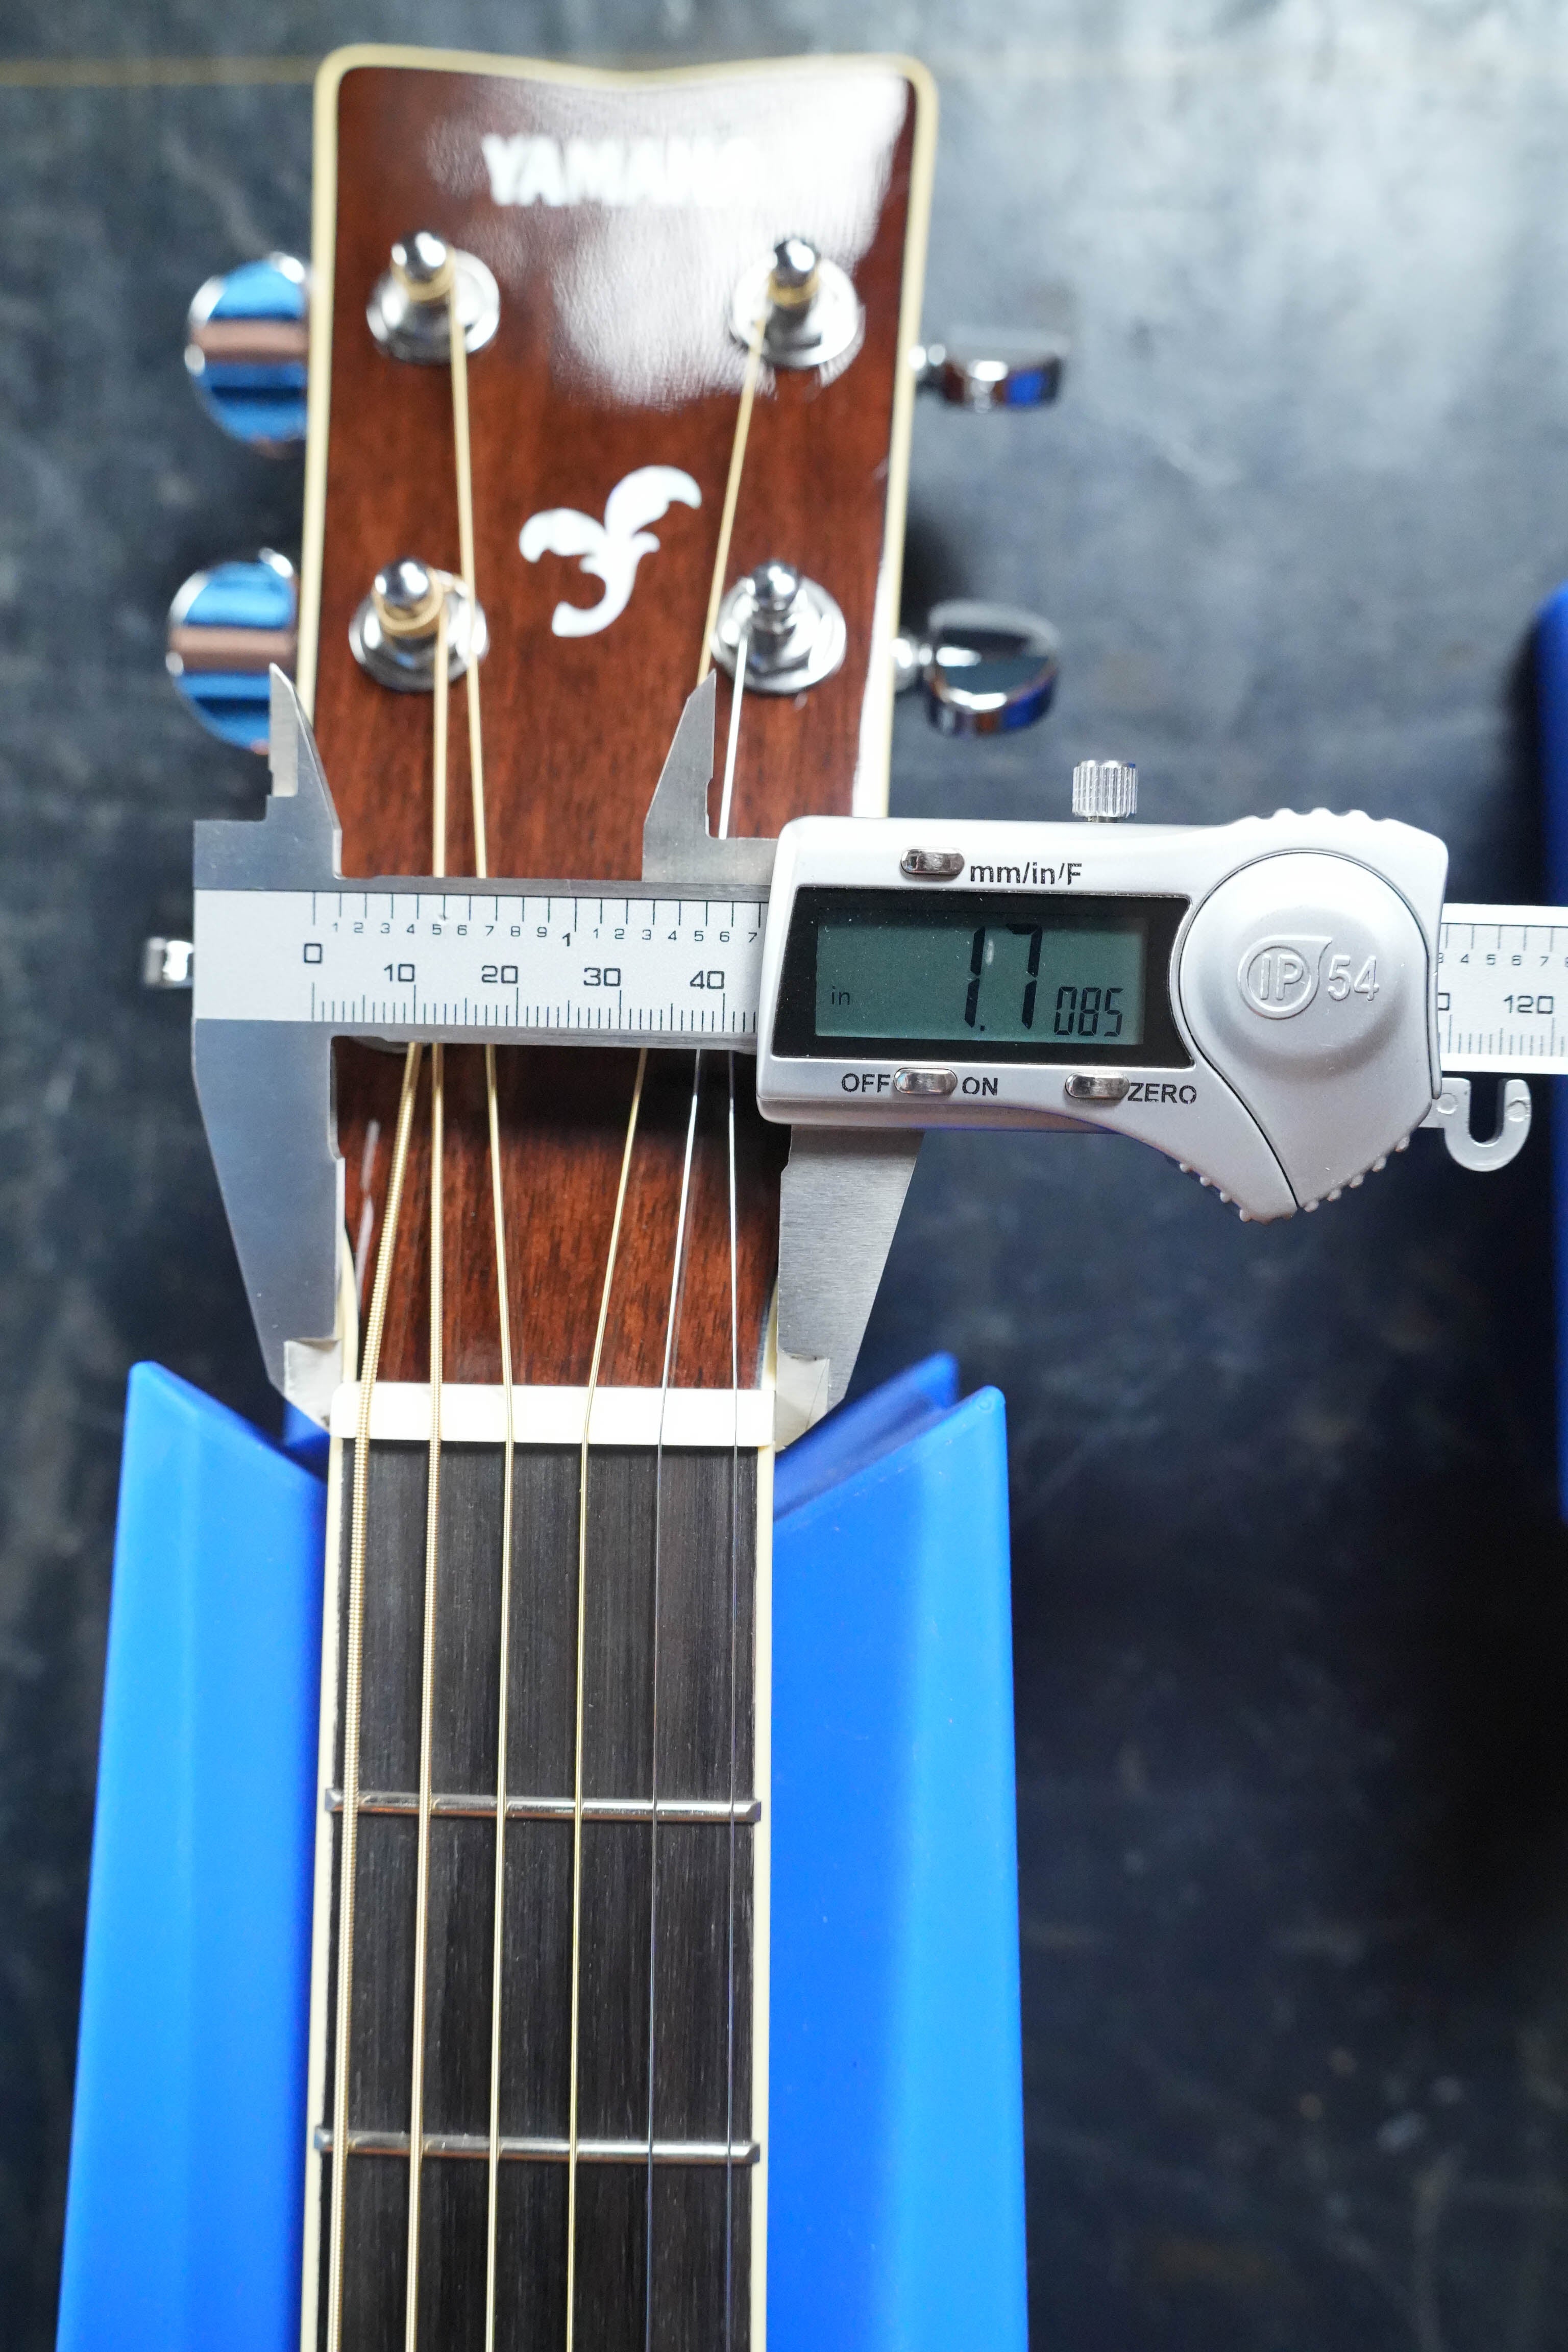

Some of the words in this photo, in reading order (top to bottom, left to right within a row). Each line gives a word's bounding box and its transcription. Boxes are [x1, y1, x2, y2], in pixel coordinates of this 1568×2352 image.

[482, 134, 764, 206] YAMA
[970, 862, 1082, 886] mm/in/F
[333, 922, 338, 932] 1
[354, 922, 364, 934] 2
[380, 922, 390, 934] 3
[406, 923, 415, 935] 4
[432, 923, 442, 936] 5
[457, 924, 468, 936] 6
[484, 925, 495, 937] 7
[510, 925, 521, 937] 8
[536, 926, 547, 938] 9
[561, 932, 571, 947] 1
[593, 927, 599, 939] 1
[614, 928, 625, 940] 2
[642, 929, 652, 941] 3
[667, 929, 677, 941] 4
[694, 930, 704, 942] 5
[719, 930, 730, 943] 6
[748, 932, 758, 943] 7
[1460, 953, 1469, 964] 4
[1486, 953, 1496, 966] 5
[1511, 955, 1522, 966] 6
[1539, 955, 1550, 967] 7
[383, 963, 415, 983] 10
[481, 965, 519, 985] 20
[583, 967, 621, 987] 30
[689, 970, 725, 990] 40
[1327, 954, 1380, 1001] 54
[831, 986, 850, 1006] in
[1503, 994, 1555, 1015] 120
[841, 1073, 891, 1093] OFF
[962, 1076, 998, 1096] ON
[1129, 1082, 1197, 1105] ZERO
